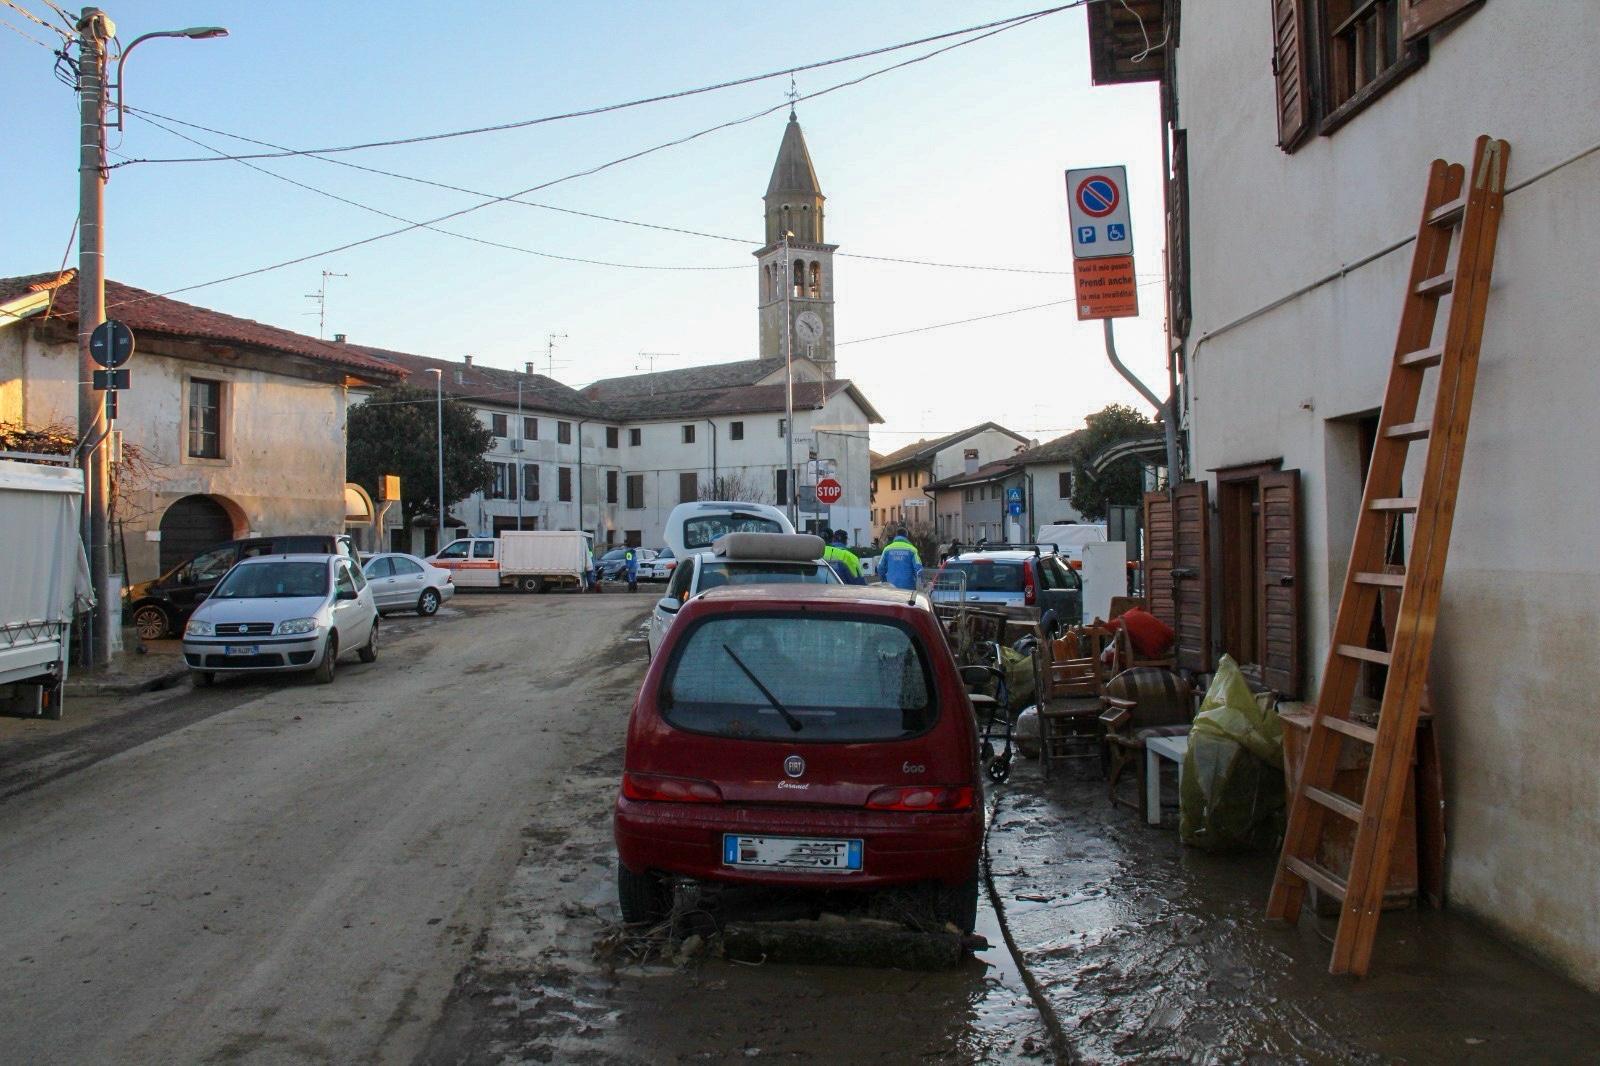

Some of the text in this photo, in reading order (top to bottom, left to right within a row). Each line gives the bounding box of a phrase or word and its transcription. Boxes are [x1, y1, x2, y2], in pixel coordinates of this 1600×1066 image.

[1082, 230, 1093, 242] P
[1079, 276, 1132, 288] Prendi anche
[1089, 292, 1100, 300] mia
[817, 486, 840, 497] STOP
[789, 761, 801, 772] FIAT
[903, 761, 925, 772] 600
[777, 780, 809, 790] Caramel
